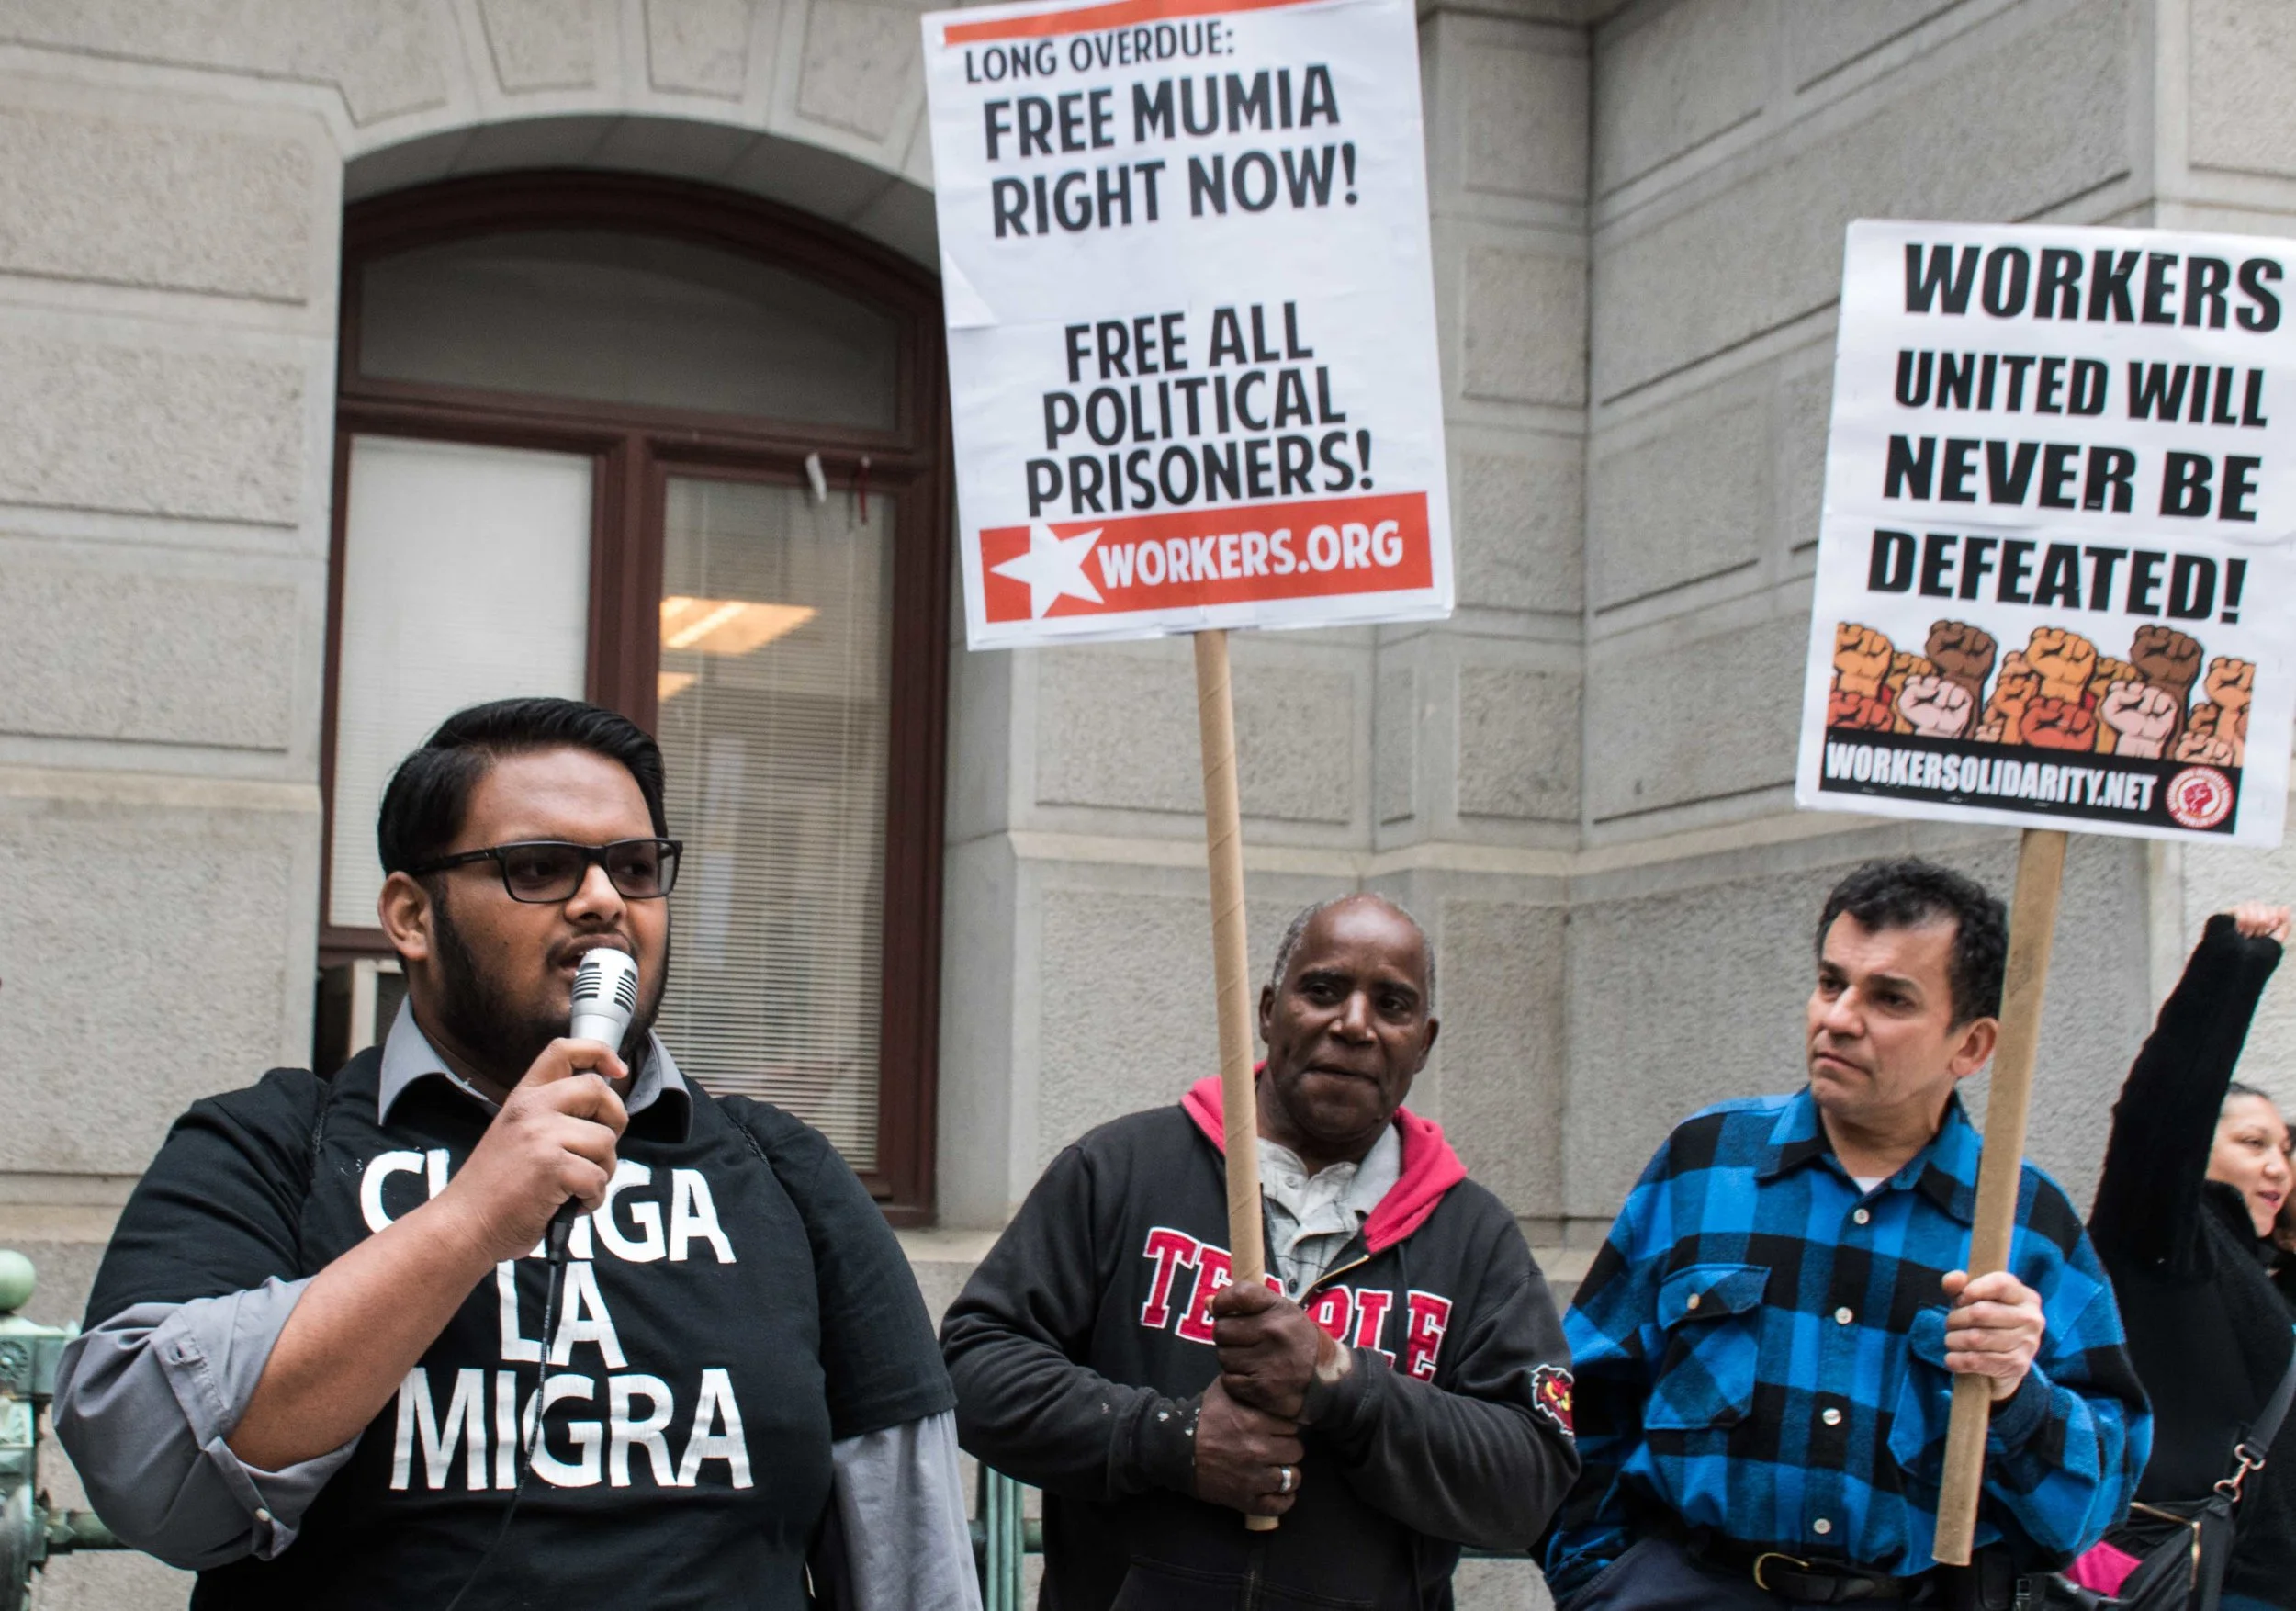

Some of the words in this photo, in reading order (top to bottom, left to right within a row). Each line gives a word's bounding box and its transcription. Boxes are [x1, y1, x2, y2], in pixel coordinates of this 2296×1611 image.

[965, 39, 1057, 84] LONG
[1069, 20, 1234, 73] OVERDUE:
[984, 88, 1115, 161] FREE
[1132, 64, 1340, 143] MUMIA
[991, 160, 1165, 239] RIGHT
[1188, 142, 1358, 218] NOW!
[1904, 242, 2284, 333] WORKERS
[1065, 311, 1188, 383] FREE
[1209, 301, 1313, 366] ALL
[1043, 366, 1346, 450] POLITICAL
[1894, 349, 2109, 416] UNITED
[2128, 361, 2268, 428] WILL
[1025, 429, 1373, 517] PRISONERS!
[1882, 434, 2138, 513] NEVER
[2158, 450, 2262, 523] BE
[1099, 520, 1403, 590] WORKERS.ORG
[1866, 528, 2248, 625] DEFEATED!
[1826, 742, 2160, 811] WORKERSOLIDARITY.NET
[360, 1148, 737, 1263] CGA
[497, 1259, 628, 1369] LA
[1141, 1226, 1453, 1383] TEPLE
[389, 1367, 754, 1491] MIGRA
